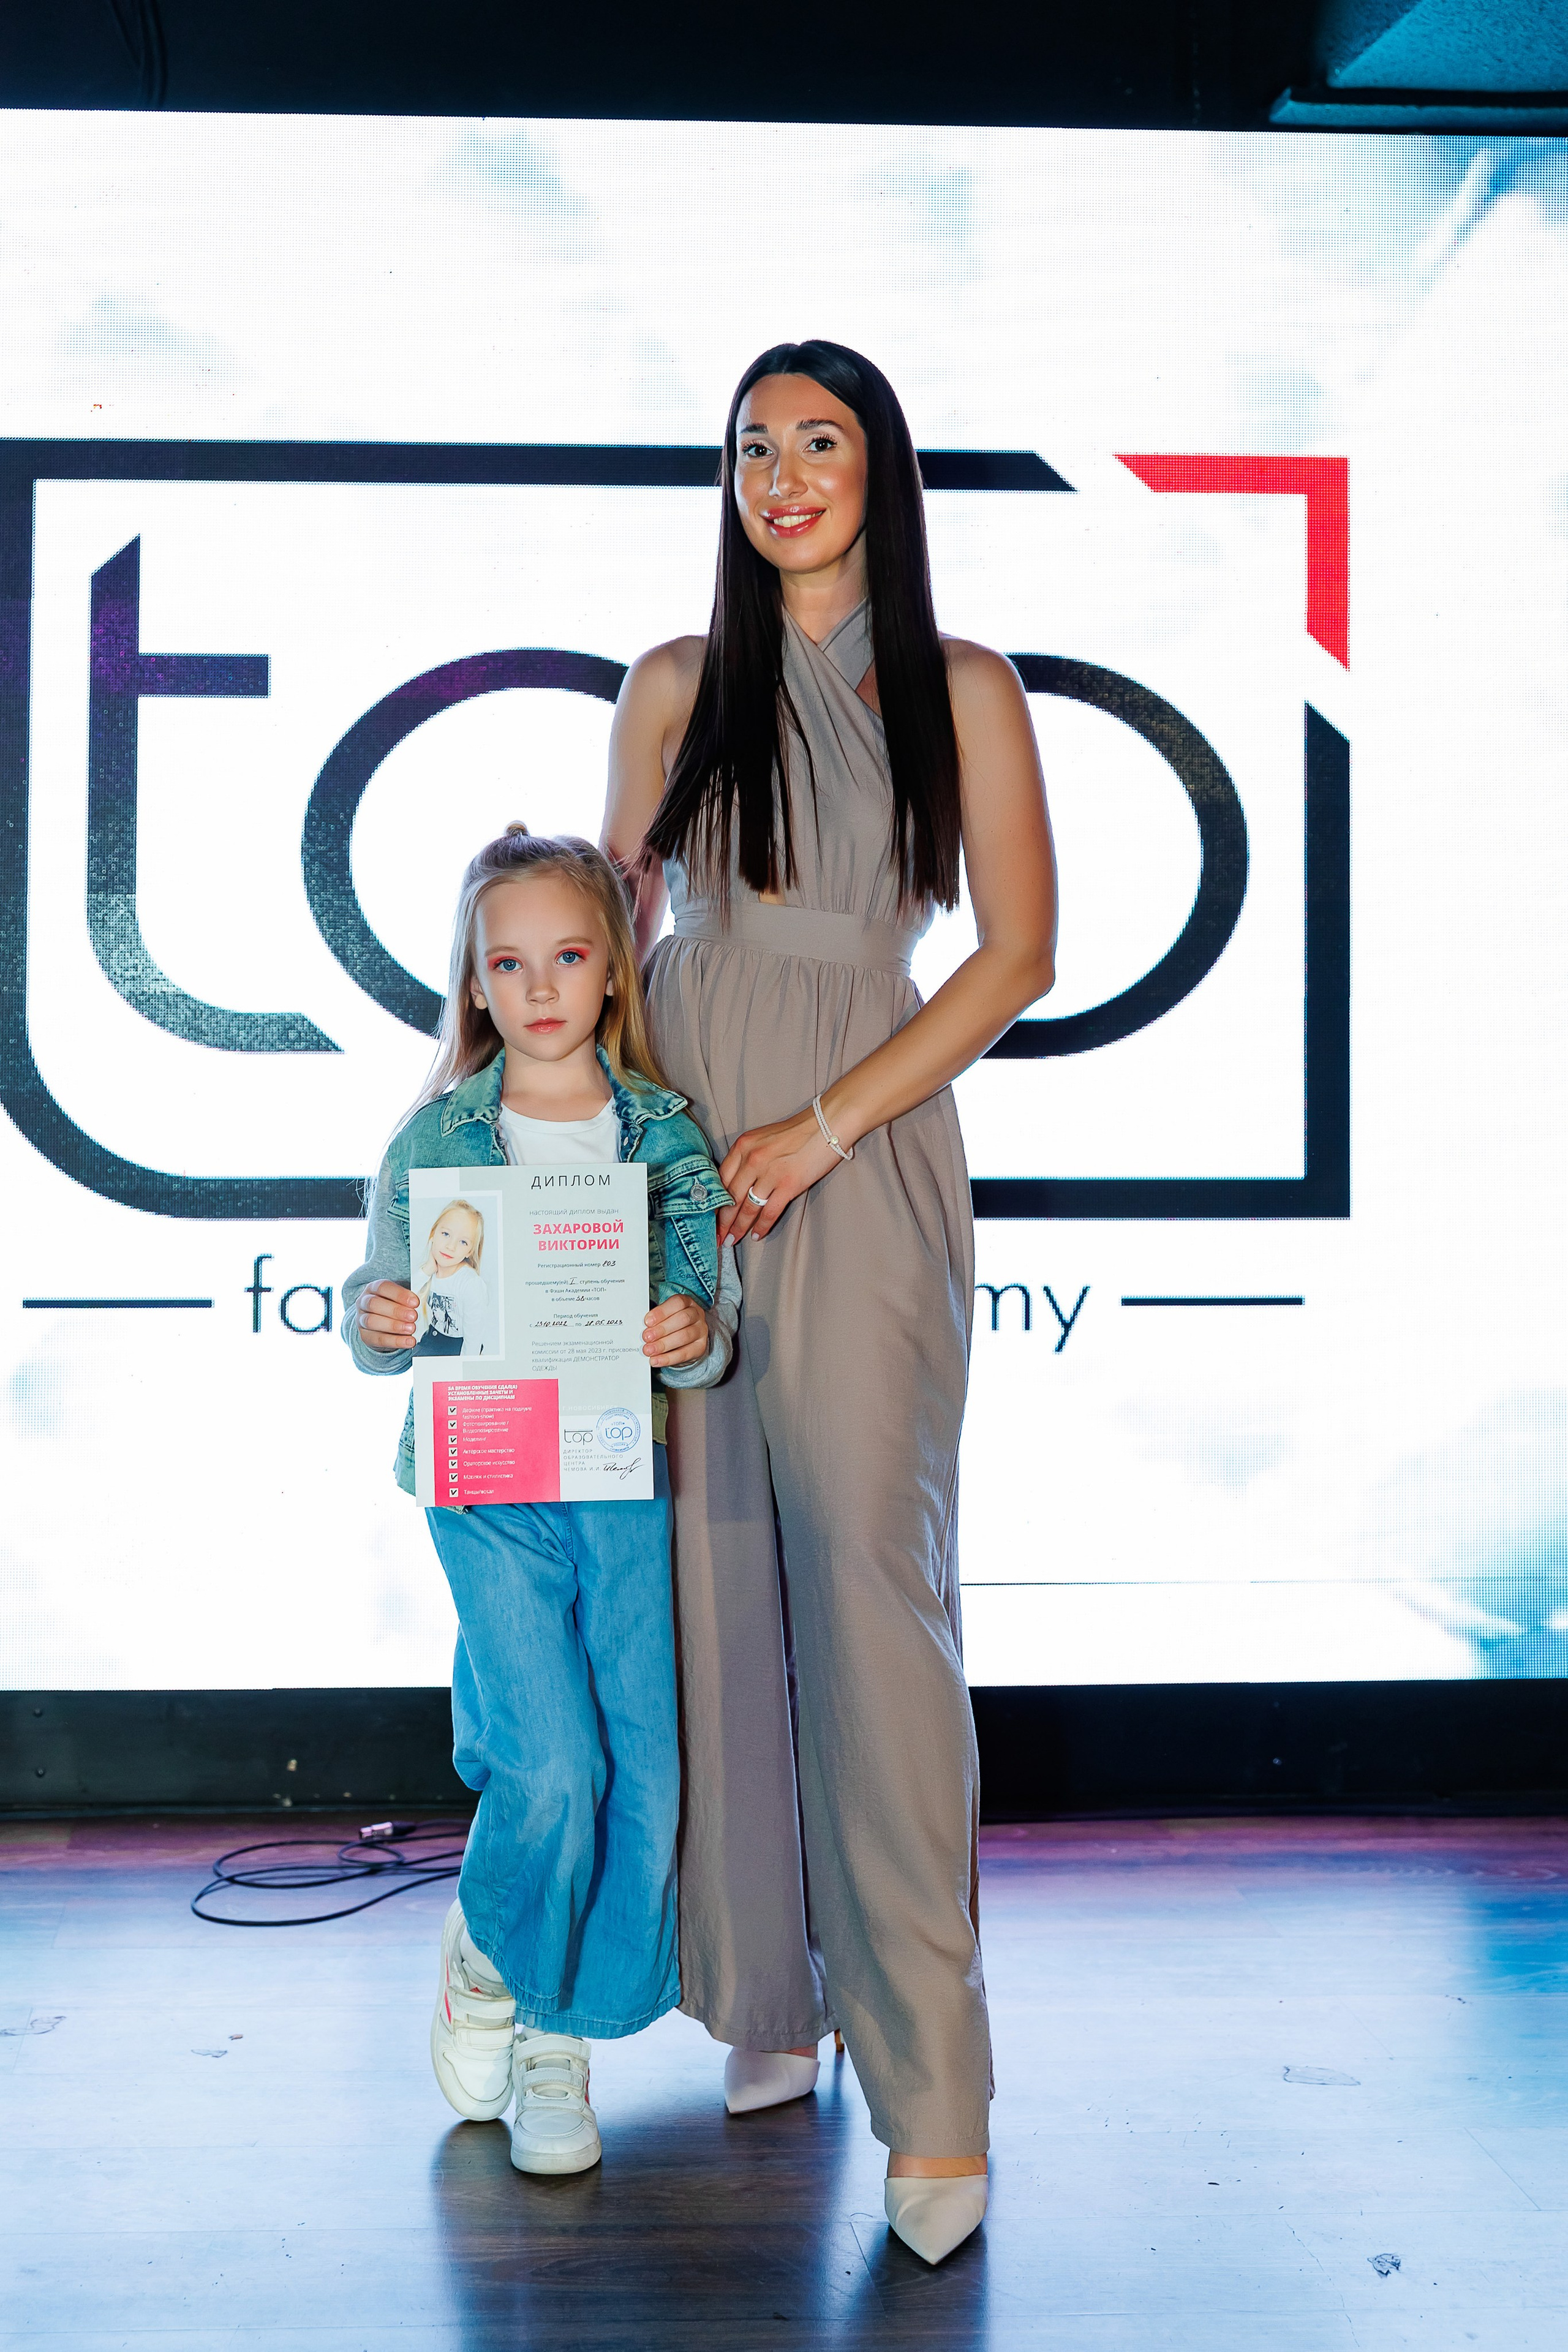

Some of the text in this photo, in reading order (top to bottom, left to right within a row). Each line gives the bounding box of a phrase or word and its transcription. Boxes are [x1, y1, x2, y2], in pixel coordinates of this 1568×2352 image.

[531, 1174, 611, 1189] ДИПЛОМ
[533, 1219, 624, 1235] ЗАХАРОВОЙ
[538, 1238, 619, 1251] ВИКТОРИИ
[564, 1429, 594, 1446] top
[605, 1427, 633, 1441] top
